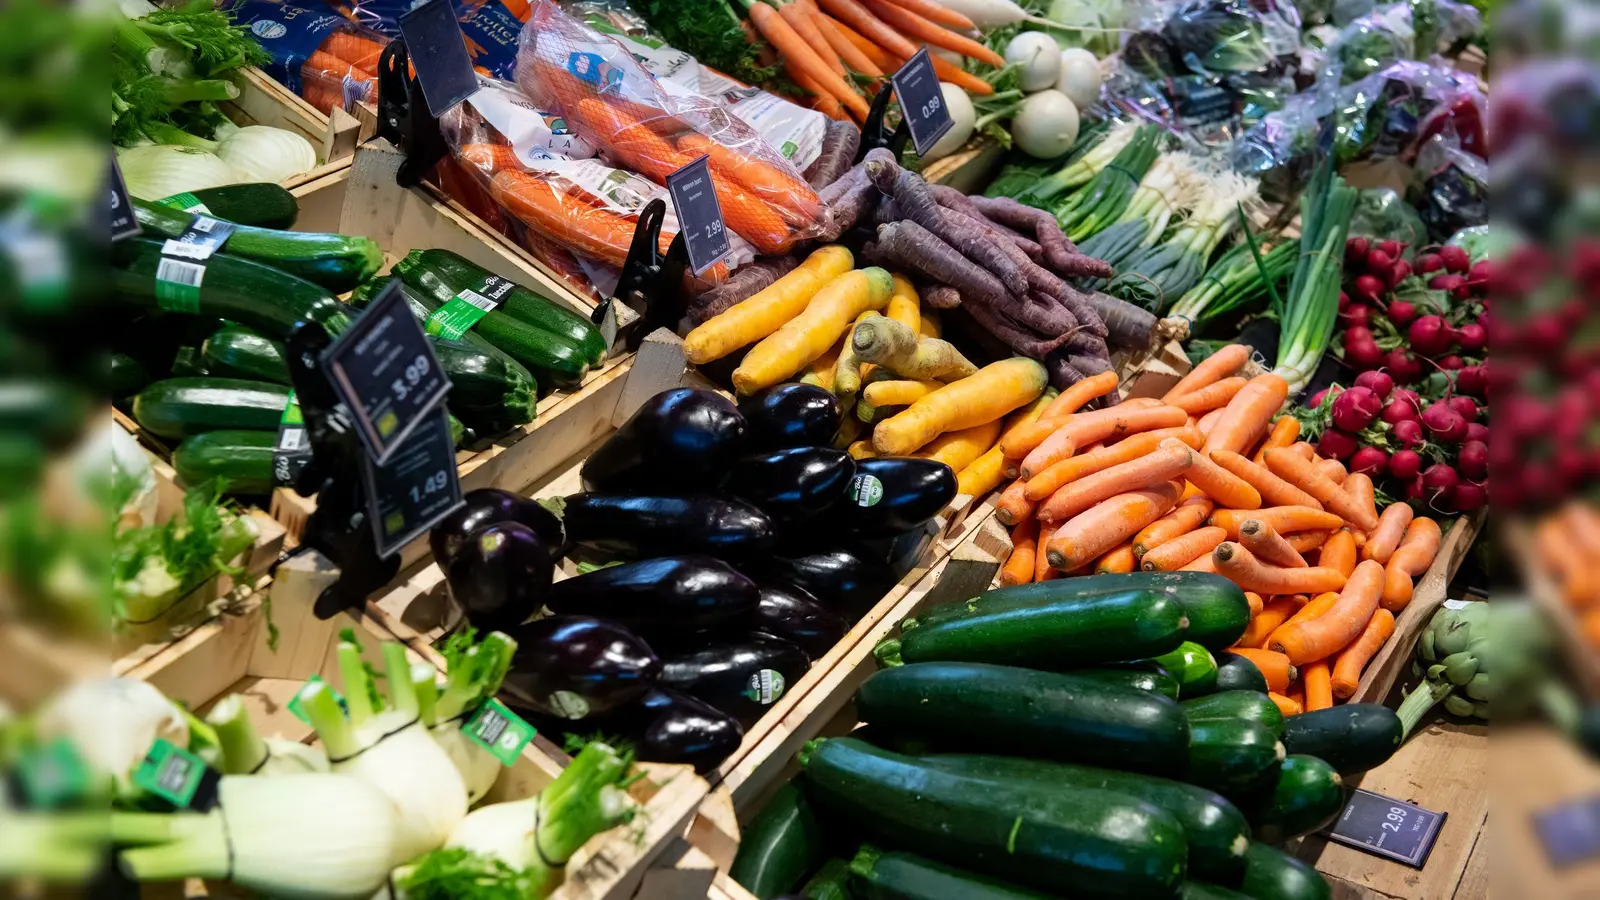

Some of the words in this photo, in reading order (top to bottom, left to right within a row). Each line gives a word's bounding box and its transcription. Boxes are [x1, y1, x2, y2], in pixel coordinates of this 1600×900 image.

[922, 96, 940, 119] 0.99
[705, 219, 722, 239] 2.99
[488, 281, 515, 300] Zucchini
[275, 456, 291, 481] Bio
[409, 470, 448, 504] 1.49
[1381, 806, 1408, 833] 2.99
